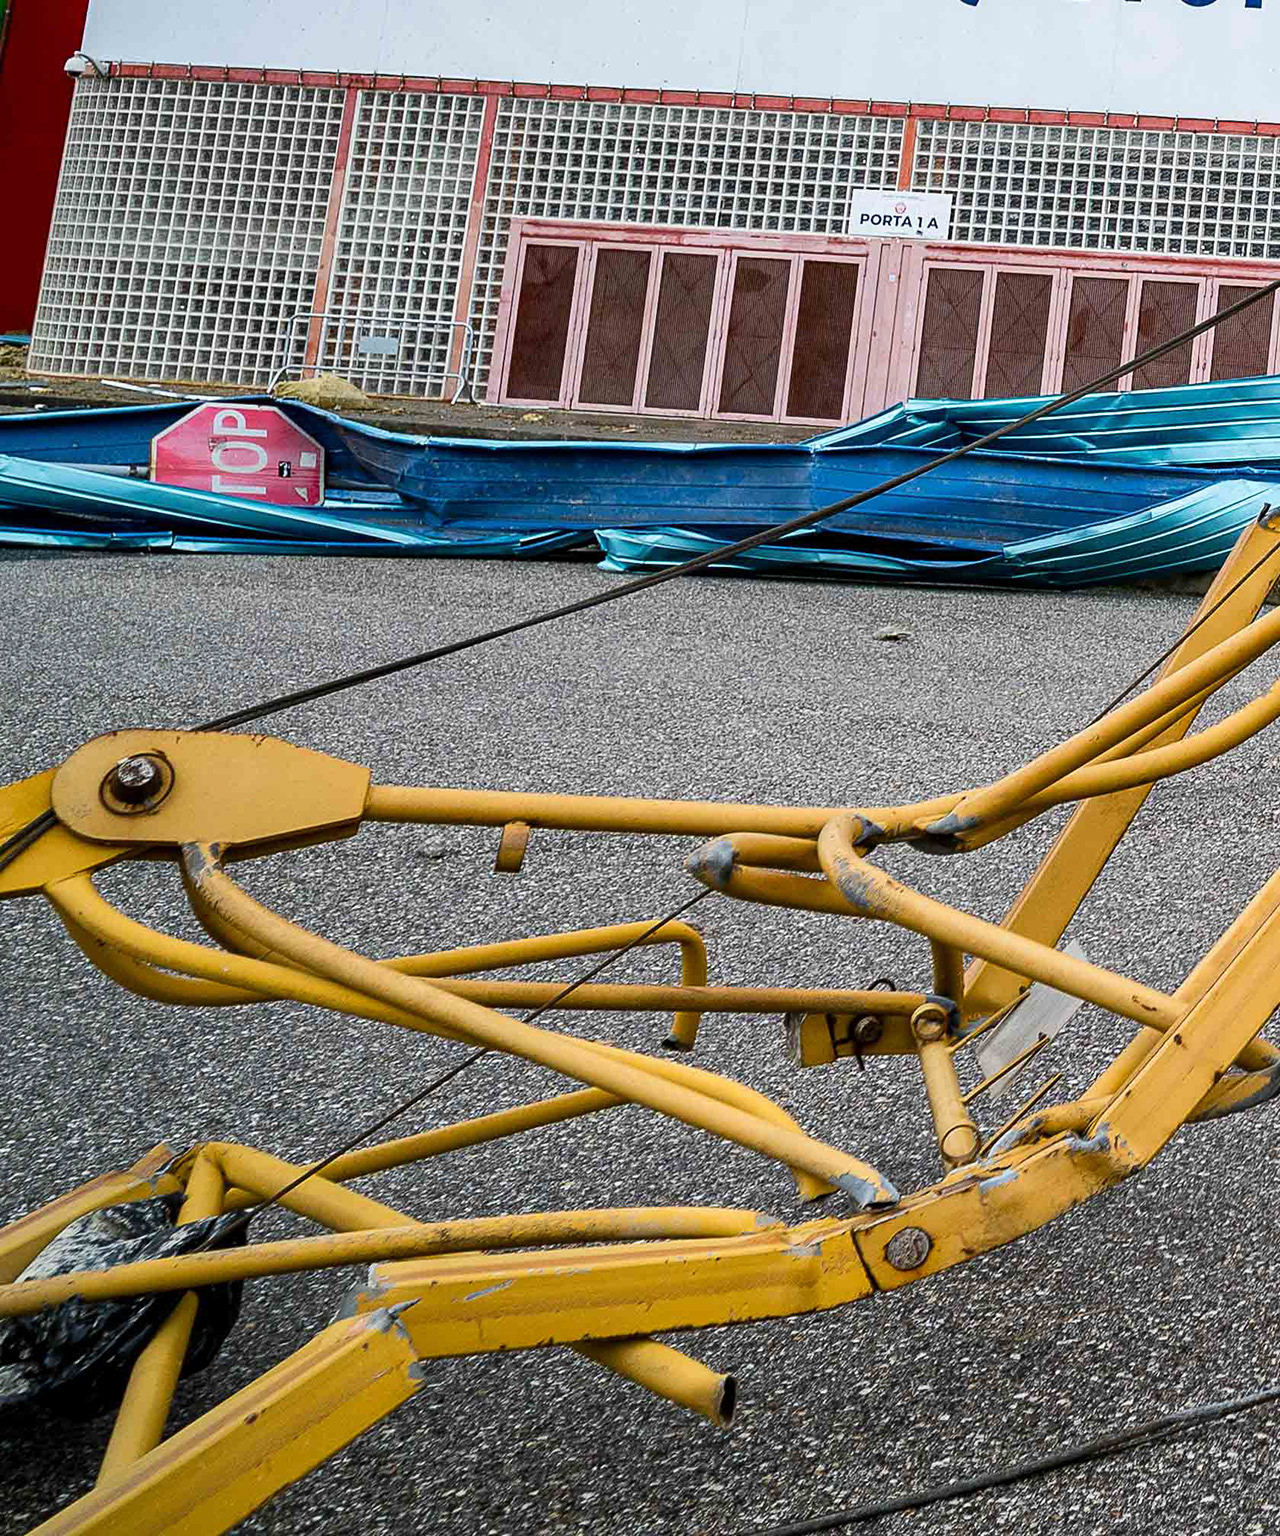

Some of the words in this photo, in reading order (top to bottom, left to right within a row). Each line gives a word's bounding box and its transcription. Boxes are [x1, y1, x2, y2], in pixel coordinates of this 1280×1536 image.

[860, 213, 912, 228] PORTA
[917, 216, 923, 228] 1
[926, 217, 939, 229] A
[211, 409, 267, 495] TOP
